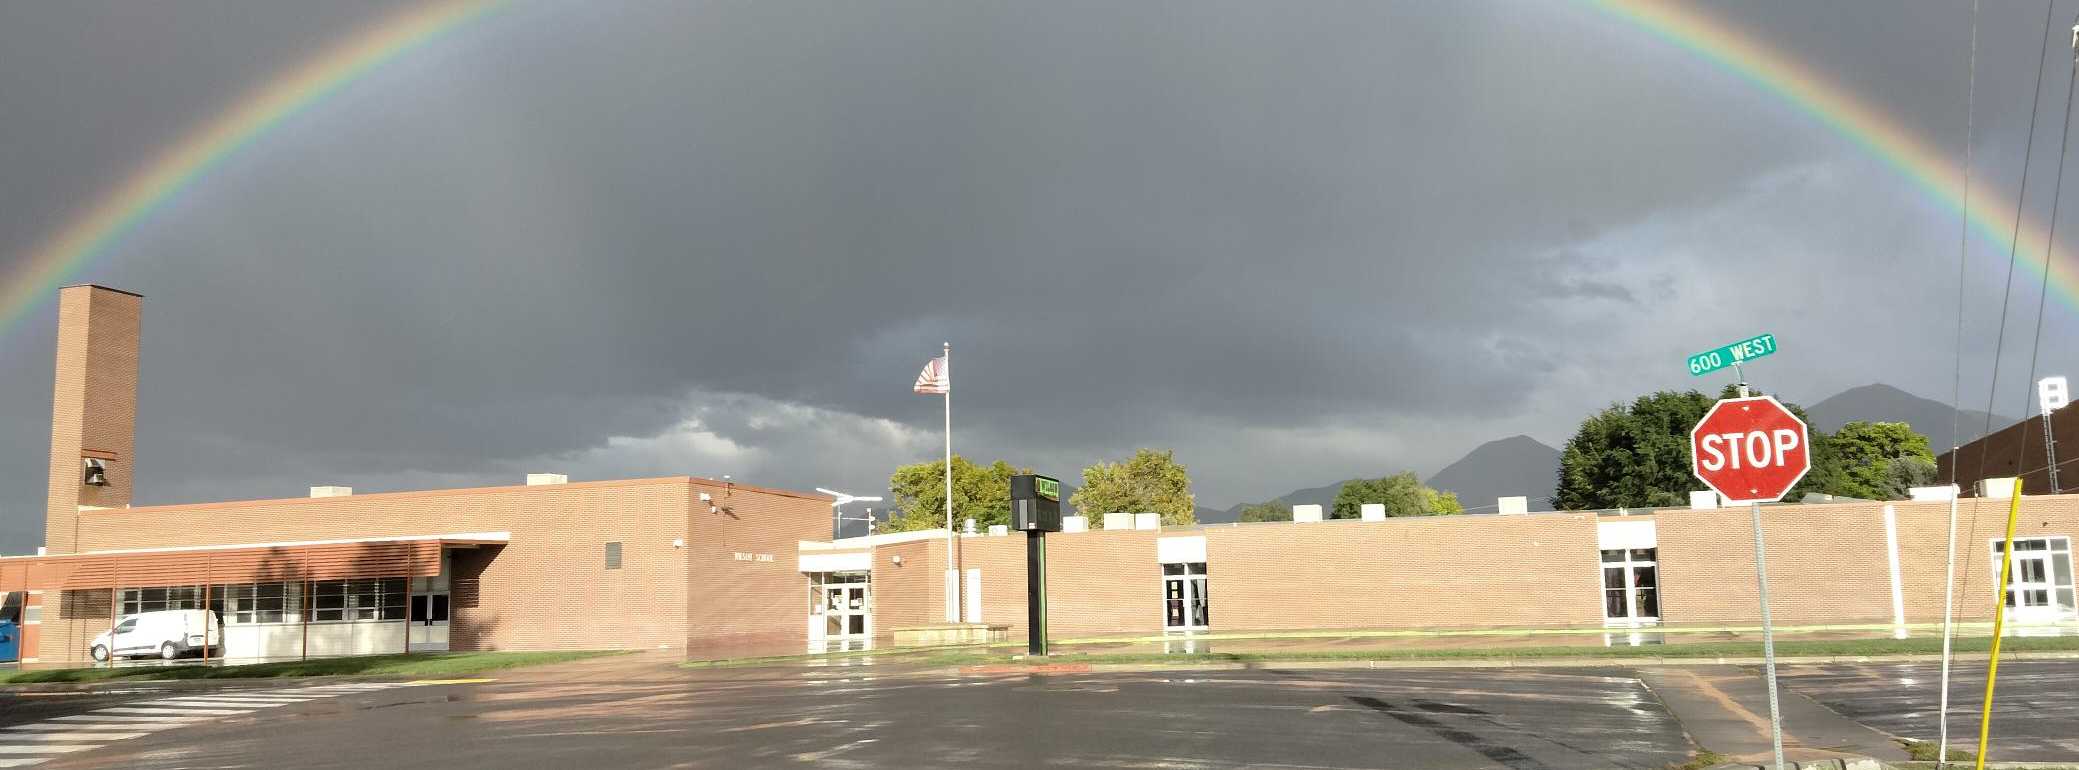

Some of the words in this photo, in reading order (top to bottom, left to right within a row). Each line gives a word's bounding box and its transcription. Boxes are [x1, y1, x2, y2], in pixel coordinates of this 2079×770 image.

[1690, 352, 1722, 373] 600
[1729, 335, 1772, 360] WEST
[1700, 429, 1799, 472] STOP
